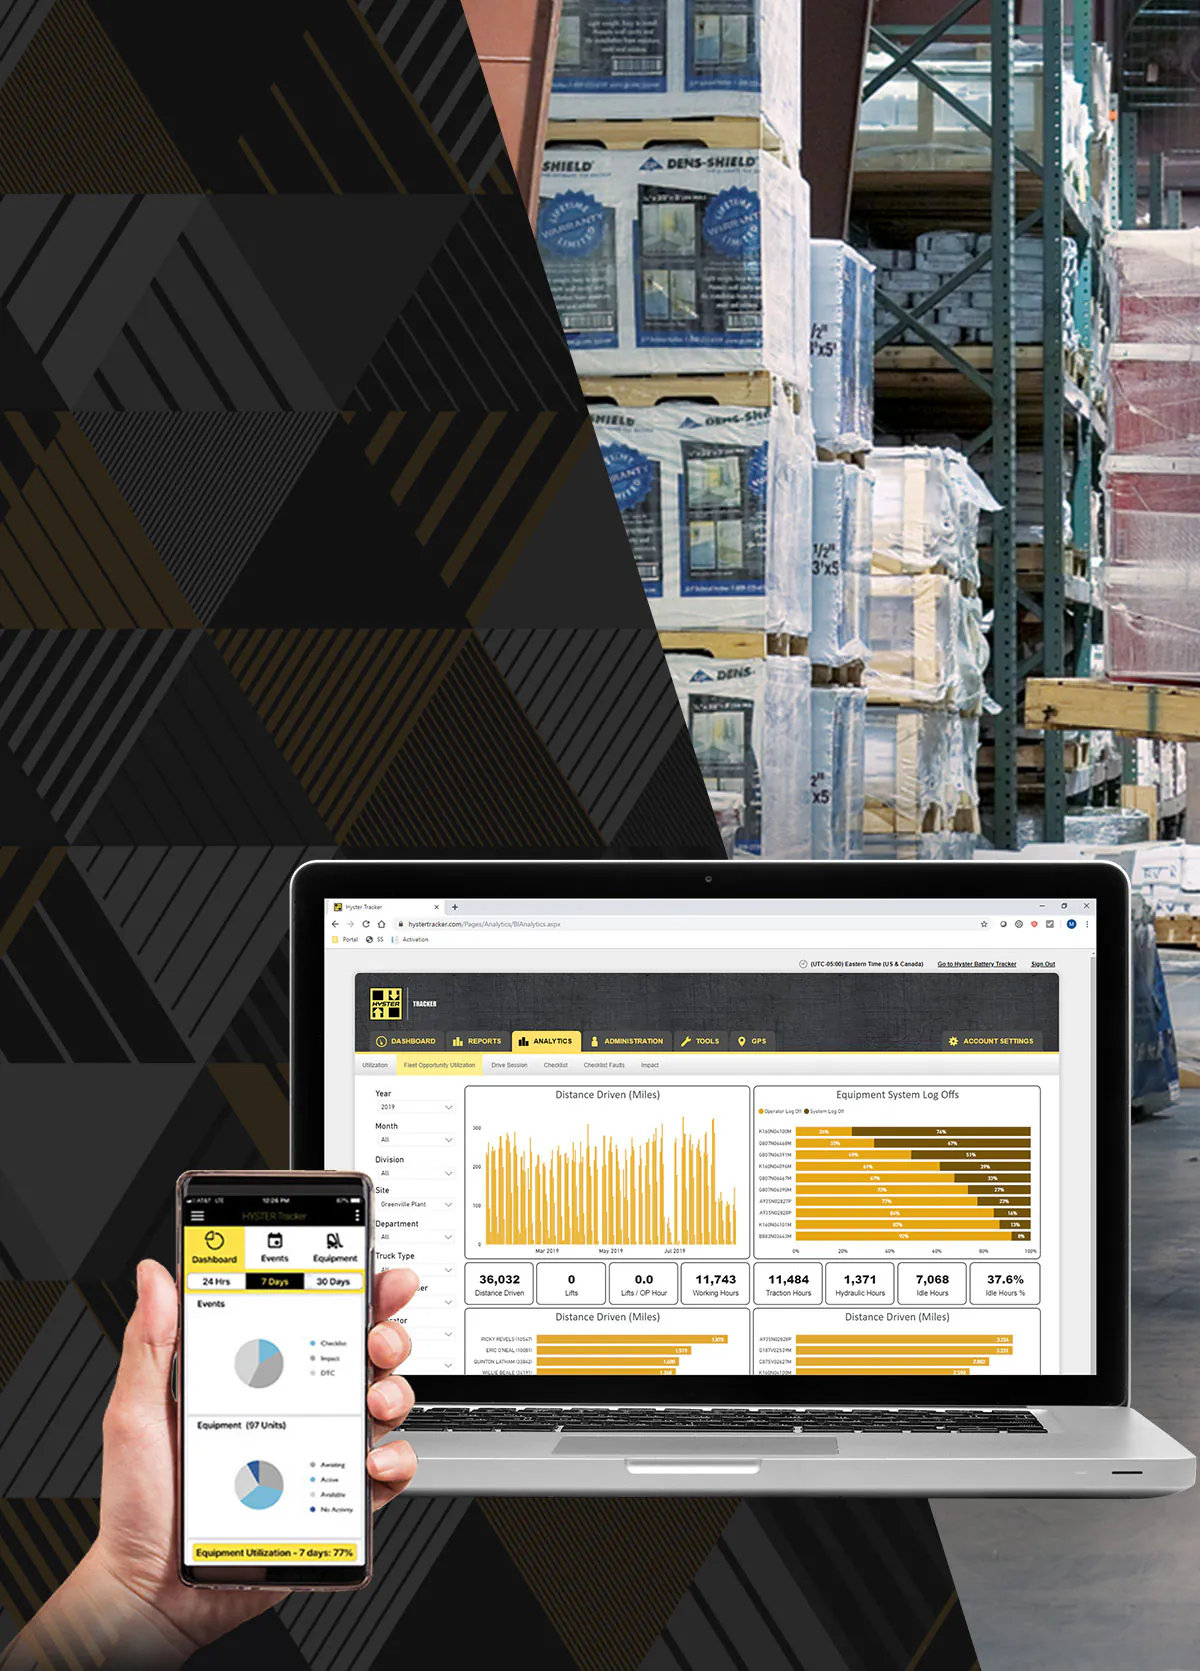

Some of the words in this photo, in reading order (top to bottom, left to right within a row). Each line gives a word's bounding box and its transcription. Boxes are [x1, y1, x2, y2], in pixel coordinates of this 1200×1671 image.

[540, 212, 603, 239] WARRANTY
[418, 1062, 448, 1070] Opportunity
[556, 1090, 594, 1099] Distance
[597, 1090, 626, 1099] Driven
[629, 1090, 660, 1100] (Miles)
[836, 1091, 885, 1100] Equipment
[888, 1091, 918, 1100] System
[921, 1091, 938, 1100] Log
[941, 1090, 959, 1098] Offs
[376, 1220, 418, 1228] Department
[261, 1254, 289, 1262] Events
[313, 1254, 358, 1263] Equipment
[398, 1252, 414, 1260] Type
[215, 1278, 230, 1286] Hrs
[266, 1278, 289, 1287] Days
[317, 1278, 328, 1286] 30
[330, 1278, 350, 1287] Days
[480, 1275, 520, 1286] 36,032
[568, 1275, 575, 1284] 0
[635, 1275, 653, 1284] 0.0
[696, 1275, 736, 1286] 11,743
[769, 1275, 809, 1286] 11,484
[844, 1275, 875, 1286] 1,371
[916, 1275, 949, 1286] 7,068
[988, 1275, 1024, 1284] 37.6%
[693, 1290, 718, 1298] Working
[836, 1290, 865, 1298] Hydraulic
[197, 1300, 225, 1308] Events
[556, 1312, 594, 1321] Distance
[597, 1312, 626, 1321] Driven
[629, 1312, 660, 1323] (Miles)
[845, 1312, 882, 1321] Distance
[886, 1312, 916, 1321] Driven
[919, 1312, 950, 1323] (Miles)
[197, 1421, 241, 1430] Equipment
[246, 1421, 259, 1430] (97
[261, 1421, 286, 1430] Units)
[196, 1549, 244, 1558] Equipment
[246, 1548, 291, 1556] Utilization
[306, 1548, 331, 1558] days:
[333, 1548, 353, 1556] 77%
